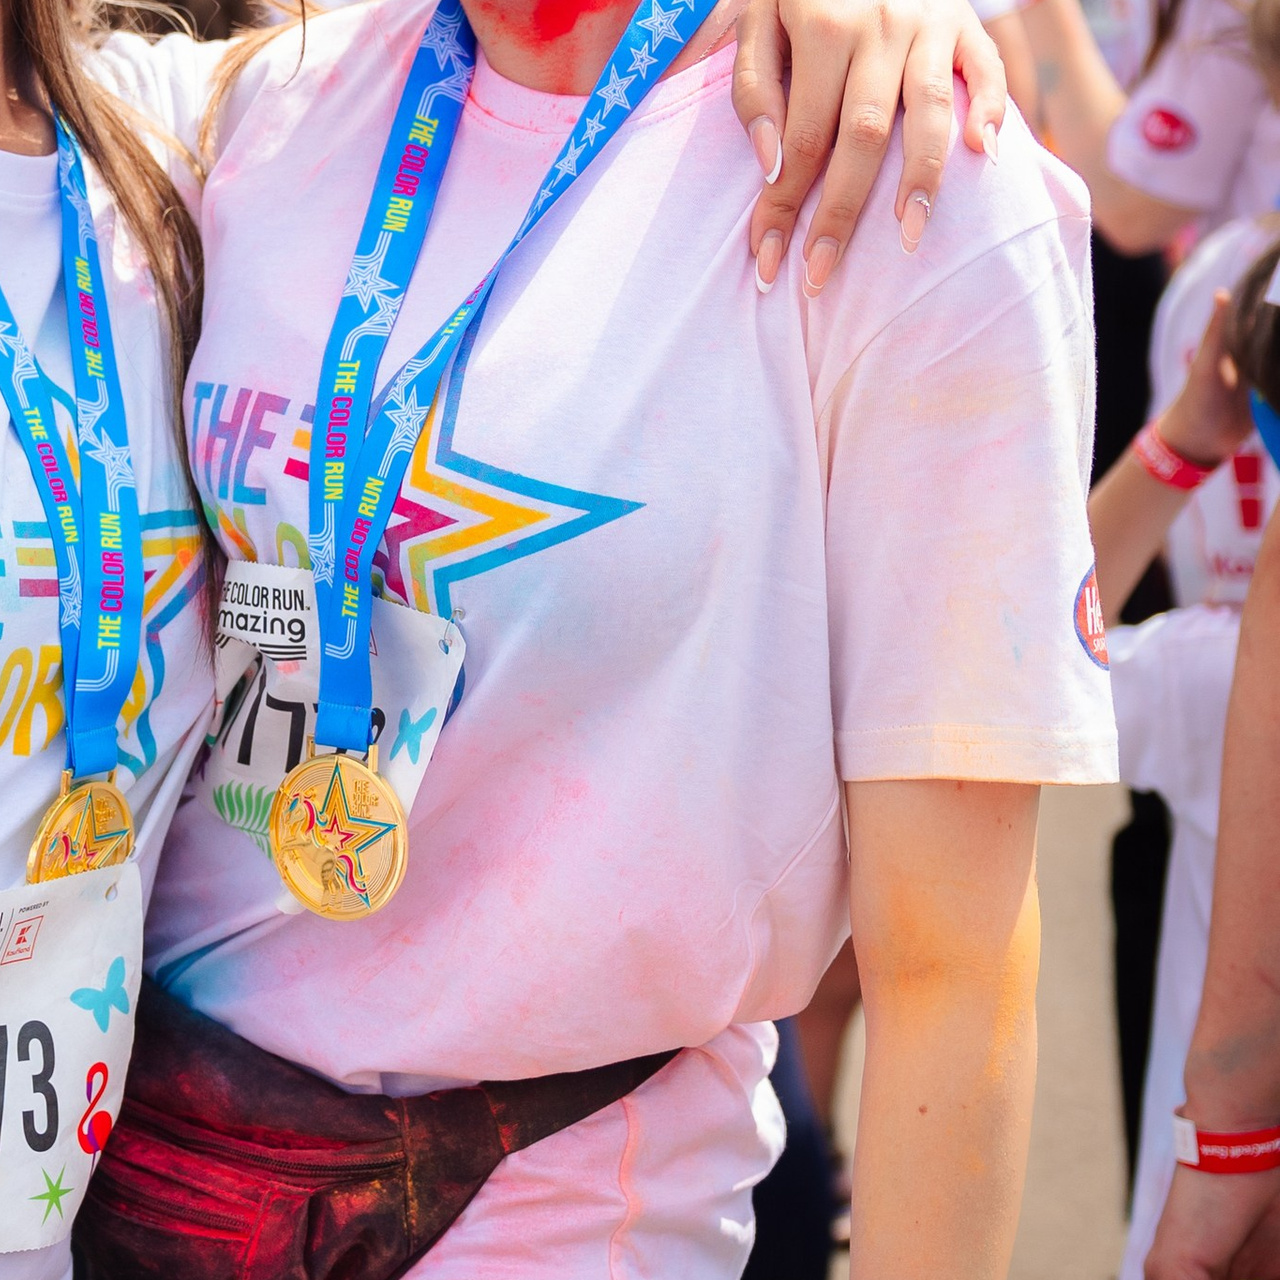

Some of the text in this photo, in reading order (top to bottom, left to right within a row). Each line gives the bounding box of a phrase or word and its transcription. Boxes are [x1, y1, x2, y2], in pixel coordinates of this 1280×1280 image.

[382, 114, 439, 234] THE COLOR RUN
[76, 256, 105, 381] THE COLOR RUN
[22, 407, 80, 544] THE COLOR RUN
[192, 381, 291, 506] THE
[324, 360, 361, 501] THE COLOR RUN
[97, 512, 124, 651] THE COLOR RUN
[230, 581, 269, 610] COLOR
[341, 477, 385, 618] THE COLOR RUN
[217, 609, 306, 644] mazing
[6, 945, 32, 958] Kaufland
